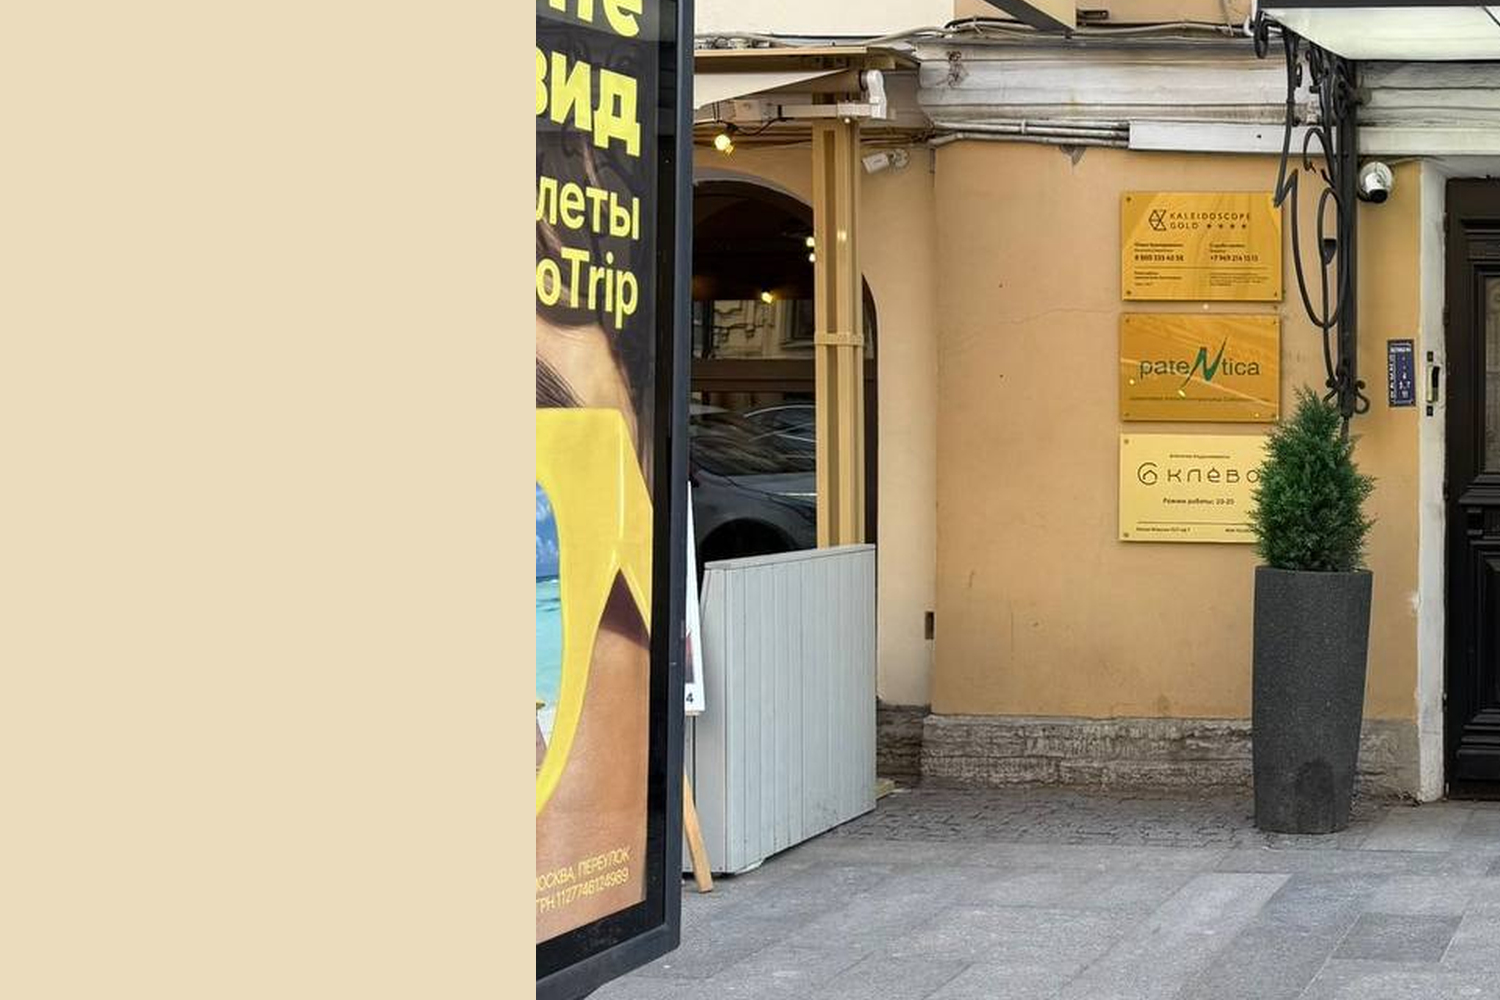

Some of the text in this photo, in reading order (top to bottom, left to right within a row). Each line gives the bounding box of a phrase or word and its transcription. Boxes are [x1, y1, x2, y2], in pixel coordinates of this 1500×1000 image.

[536, 175, 640, 240] леты
[1169, 212, 1250, 221] KALEIDOSCOPE
[1169, 222, 1199, 230] GOLD
